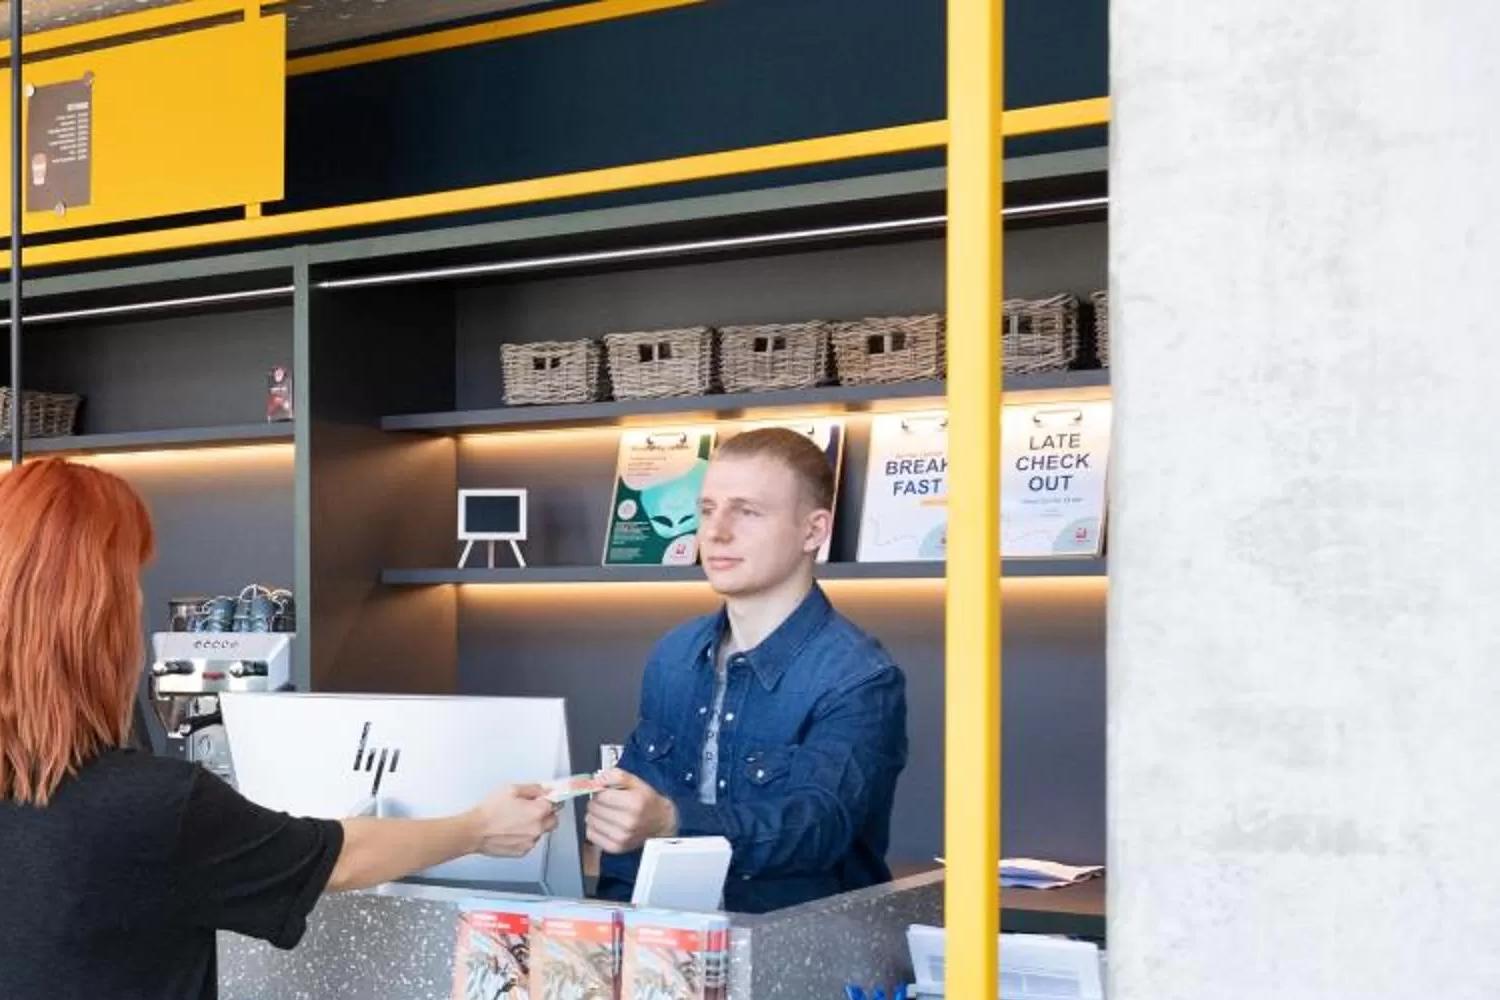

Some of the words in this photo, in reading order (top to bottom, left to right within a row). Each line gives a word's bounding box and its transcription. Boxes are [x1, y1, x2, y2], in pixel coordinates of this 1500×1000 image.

[1029, 433, 1081, 450] LATE
[1016, 453, 1090, 471] CHECK
[893, 479, 942, 496] FAST
[1028, 475, 1073, 491] OUT
